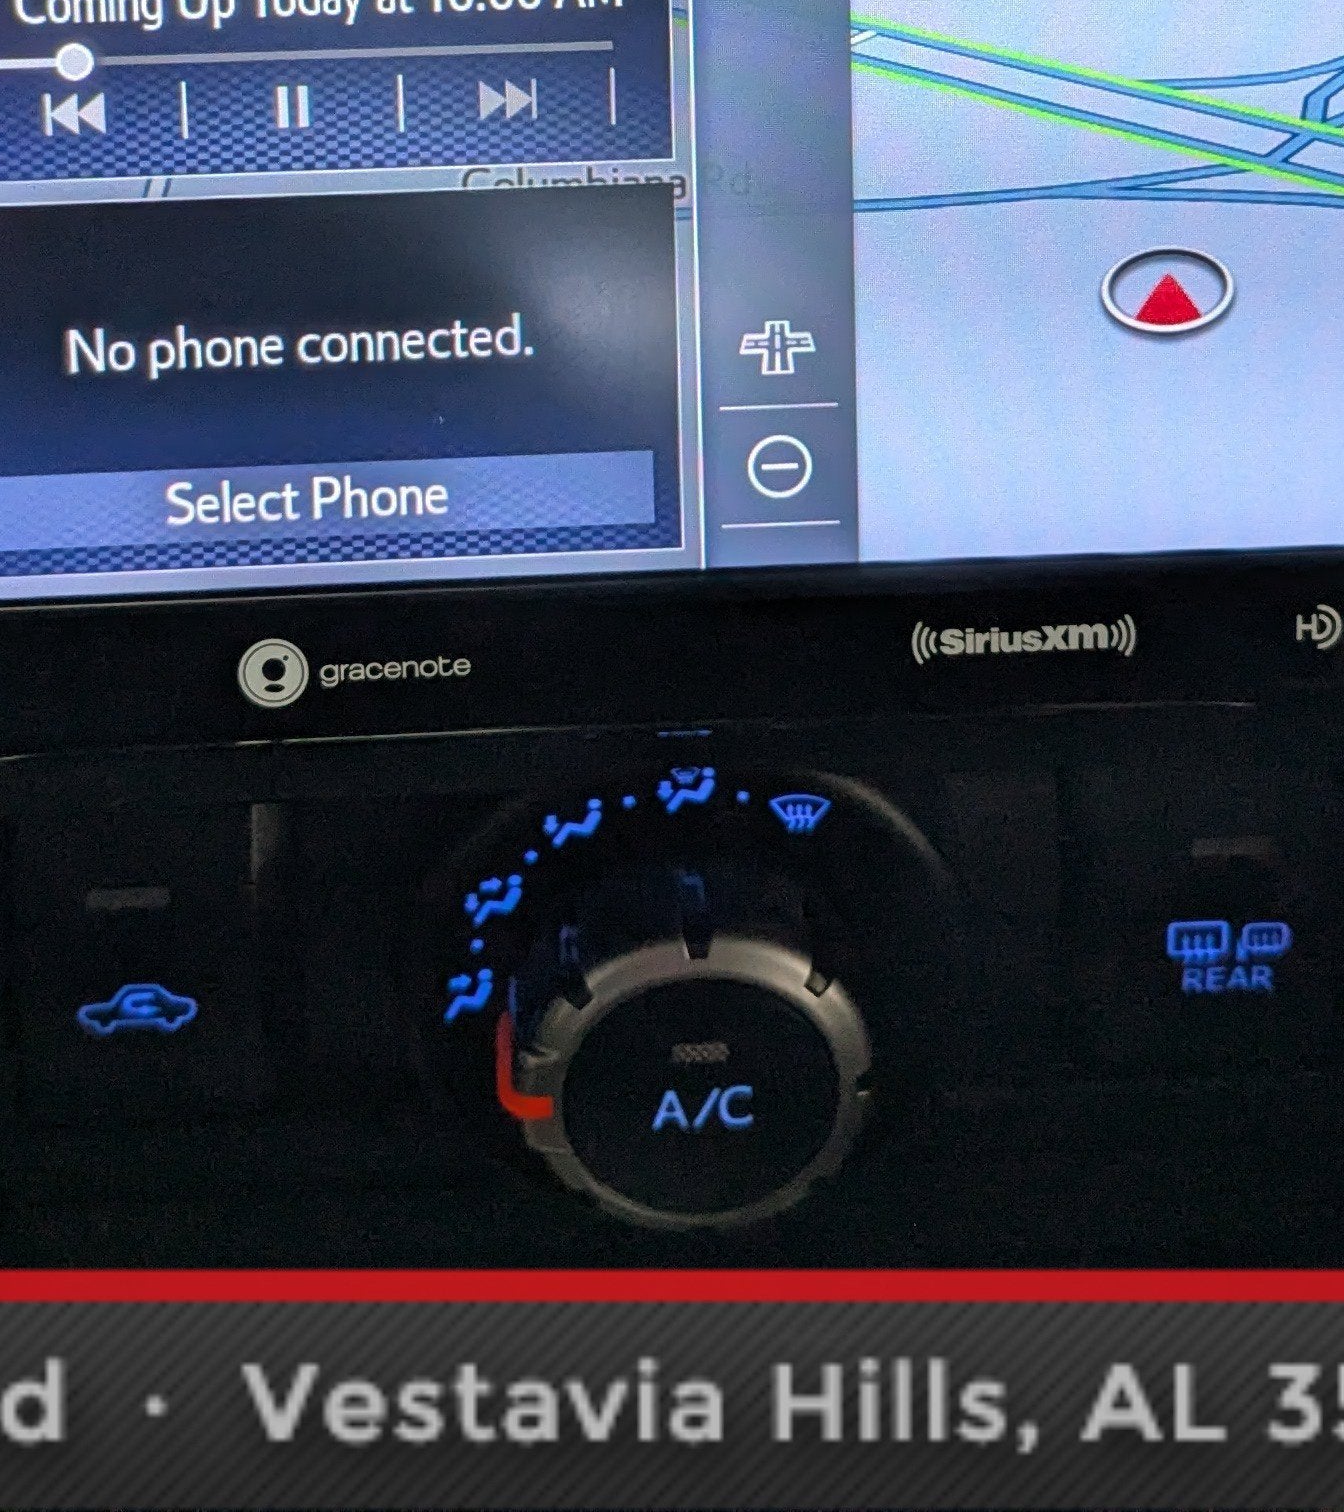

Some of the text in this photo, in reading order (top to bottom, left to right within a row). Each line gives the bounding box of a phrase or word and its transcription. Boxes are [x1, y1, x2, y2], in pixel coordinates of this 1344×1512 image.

[67, 313, 535, 382] No phone connected.
[166, 473, 450, 525] Select Phone
[319, 656, 472, 688] gracenote
[1181, 964, 1275, 993] REAR
[652, 1085, 755, 1132] A/C
